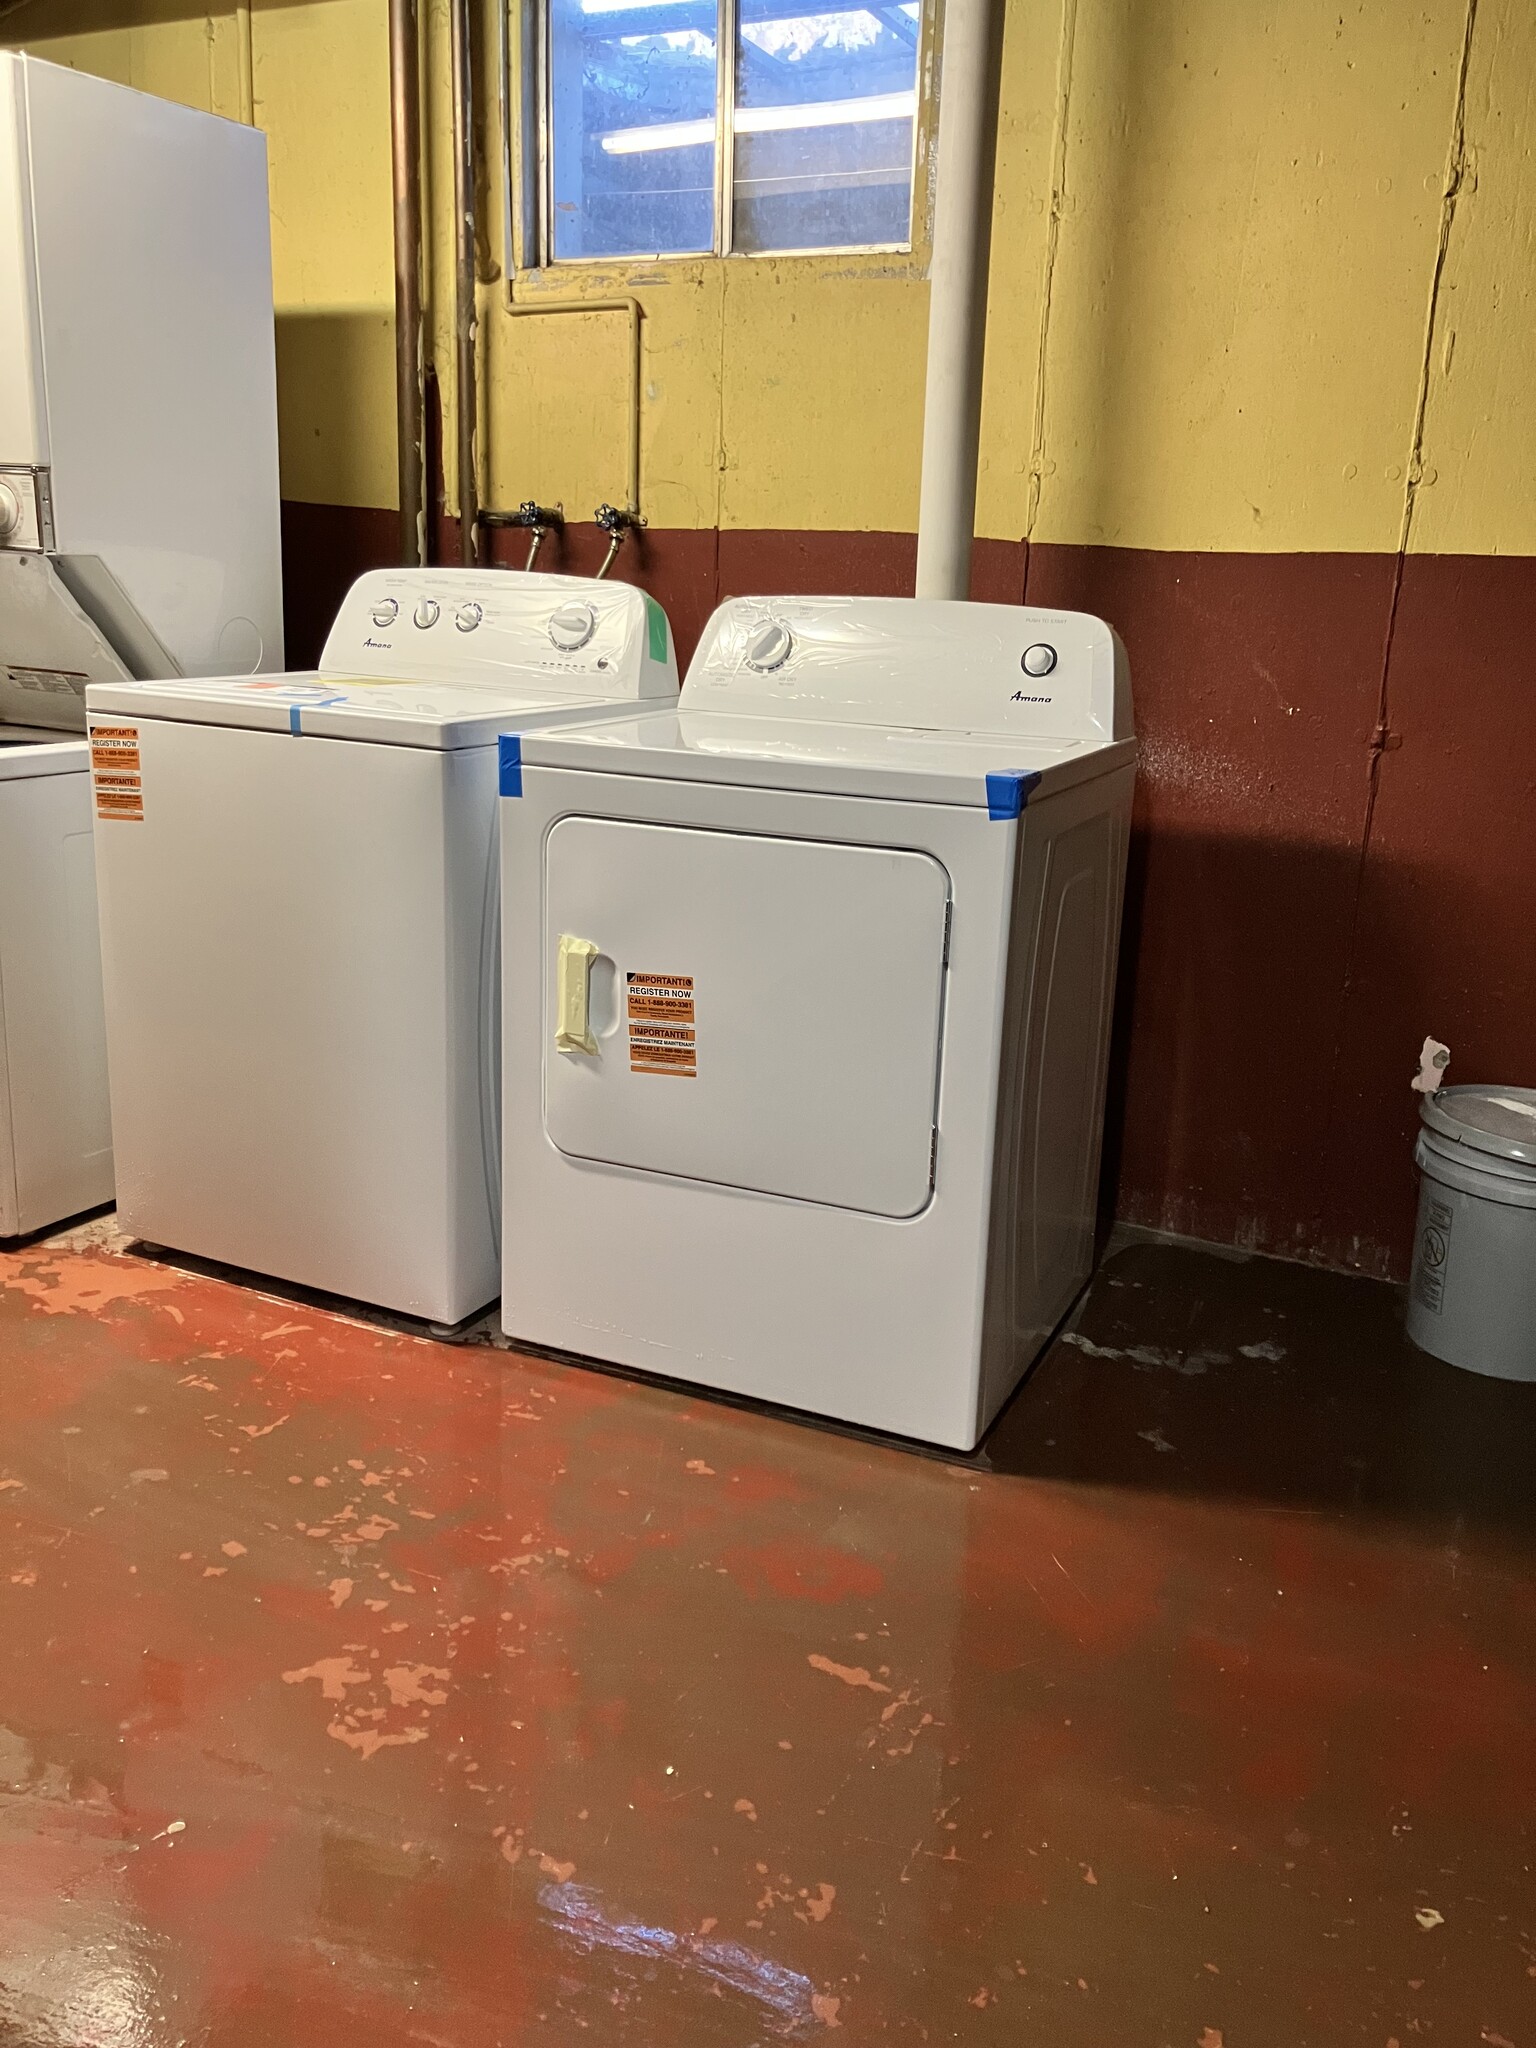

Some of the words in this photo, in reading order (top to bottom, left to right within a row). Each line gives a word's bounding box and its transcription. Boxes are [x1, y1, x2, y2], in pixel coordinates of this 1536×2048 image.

[362, 637, 393, 649] Amana
[1009, 690, 1053, 703] Amana
[92, 739, 121, 747] REGISTER
[122, 740, 137, 748] NOW
[636, 975, 685, 986] IMPORTANT!
[629, 987, 670, 997] REGISTER
[671, 990, 692, 998] NOW
[634, 1027, 689, 1039] IMPORTANTE!
[663, 1040, 695, 1048] MAINTENANT
